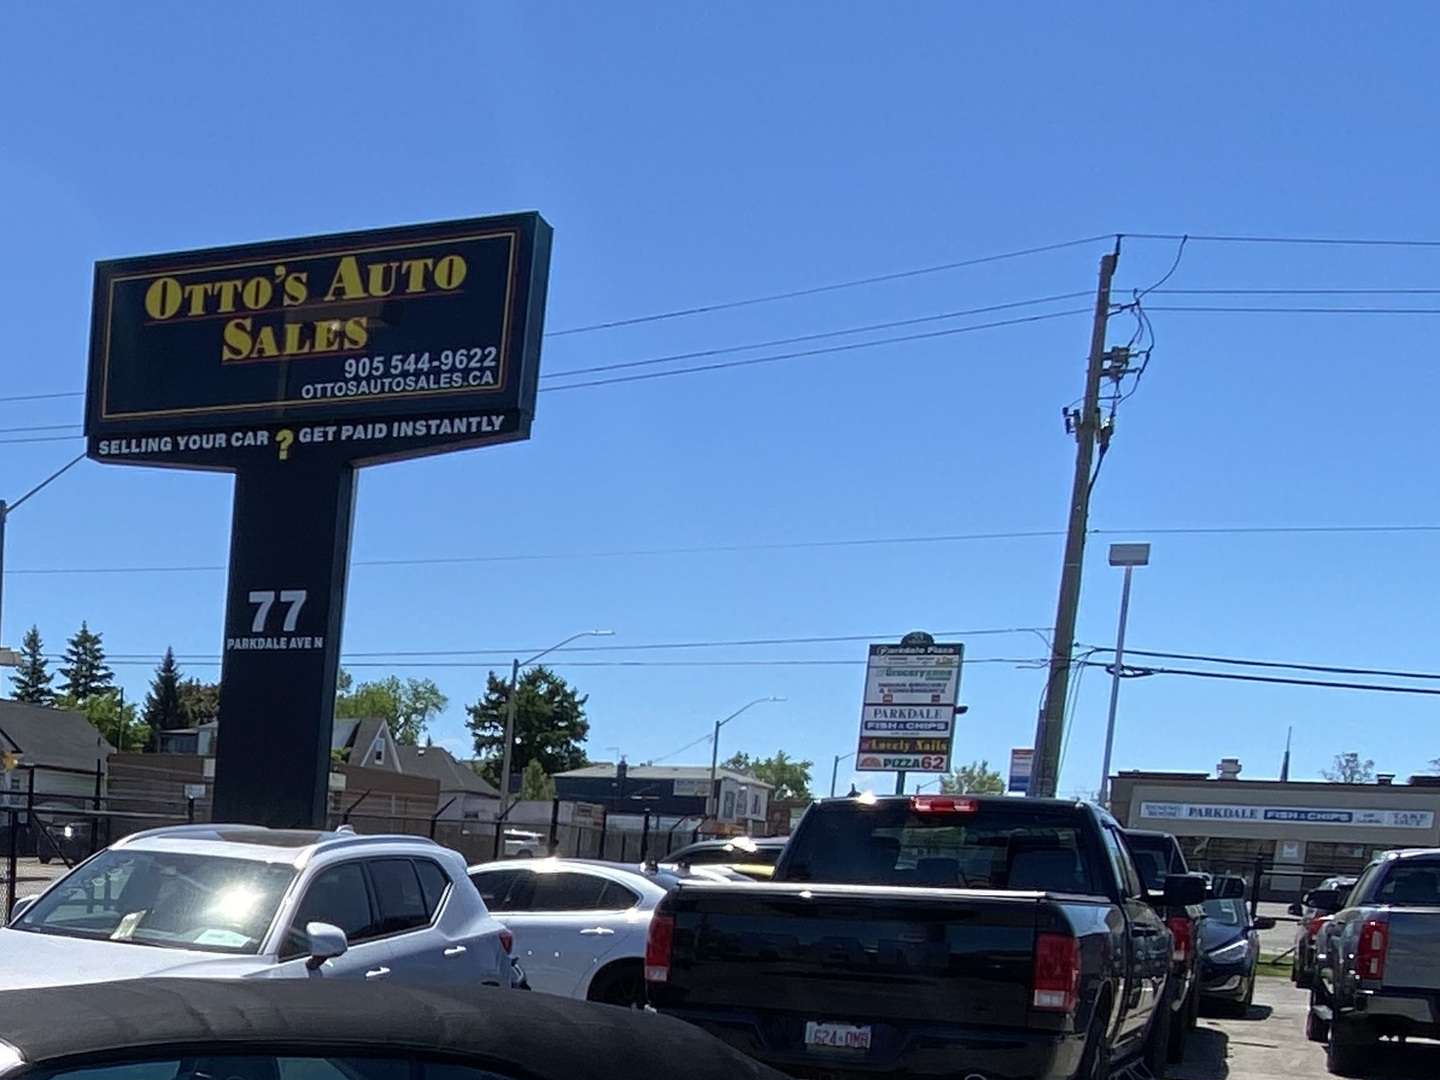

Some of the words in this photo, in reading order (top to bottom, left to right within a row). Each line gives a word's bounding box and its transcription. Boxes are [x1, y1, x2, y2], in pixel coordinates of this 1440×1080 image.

[324, 254, 468, 301] AUTO
[222, 316, 369, 361] SALES
[344, 356, 385, 379] 905
[390, 347, 498, 376] 544-9622
[301, 370, 495, 400] OTTOSAUTOSALES.CA
[98, 434, 173, 456] SELLING
[177, 432, 227, 452] YOUR
[230, 430, 270, 448] CAR
[298, 425, 337, 444] GET
[340, 421, 388, 441] PAID
[392, 415, 505, 438] INSTANTLY
[248, 590, 308, 633] 77
[227, 638, 288, 650] PARKDALE
[289, 637, 312, 649] AVE
[314, 637, 324, 648] N
[866, 721, 898, 730] FISH
[905, 721, 947, 730] CHIPS
[873, 708, 943, 720] PARKDALE
[883, 759, 921, 769] PIZZA
[921, 756, 945, 770] 62
[1188, 807, 1259, 819] PARKDALE
[1265, 810, 1298, 820] FISH
[1306, 811, 1351, 822] CHIPS
